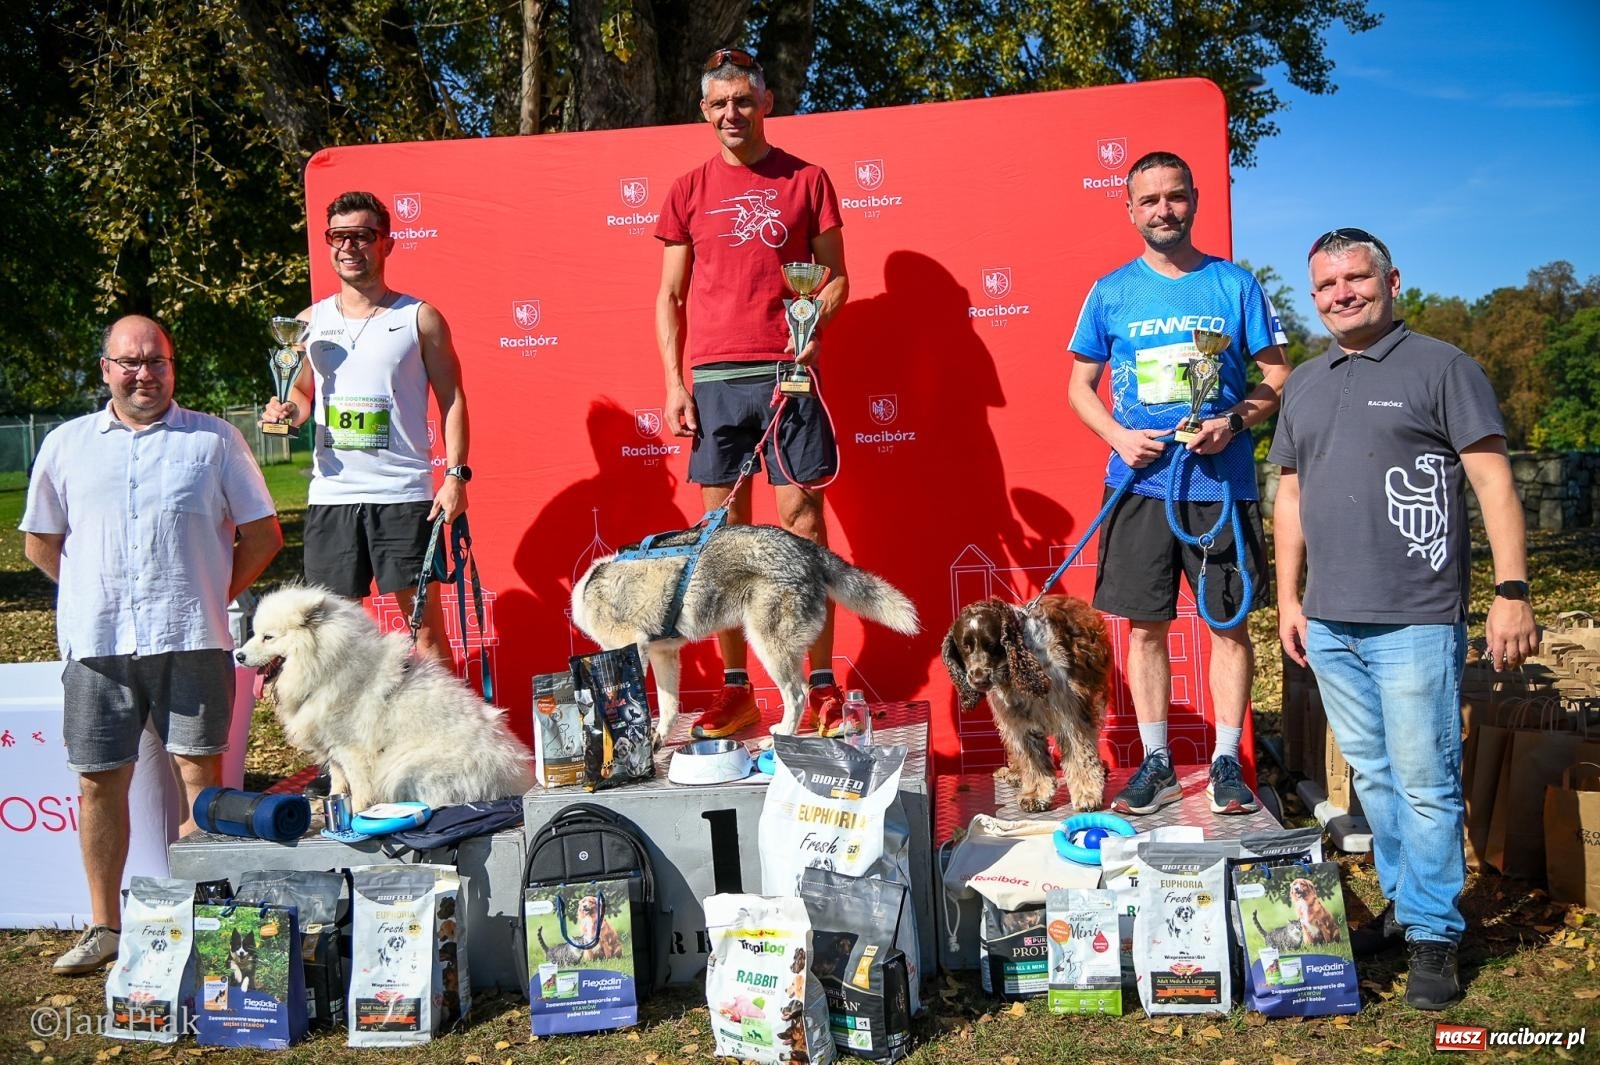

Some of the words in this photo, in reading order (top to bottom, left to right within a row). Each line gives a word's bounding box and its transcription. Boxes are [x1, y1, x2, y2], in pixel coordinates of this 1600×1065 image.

[1083, 175, 1129, 189] Racibó
[1106, 190, 1123, 199] 1217
[842, 195, 902, 209] Racibórz
[607, 212, 660, 226] Racibór
[864, 210, 880, 218] 1217
[390, 228, 438, 240] acibórz
[630, 228, 645, 236] 1217
[402, 242, 417, 251] 1217
[969, 304, 1029, 318] Racibórz
[992, 320, 1008, 329] 1217
[1127, 316, 1225, 338] TENNECO
[500, 335, 558, 348] Racibórz
[522, 350, 537, 359] 1217
[1368, 400, 1403, 408] RACIBÓRZ
[340, 411, 365, 429] 81
[856, 430, 916, 443] Racibórz
[622, 443, 680, 457] Racibórz
[878, 446, 894, 454] 1217
[811, 773, 865, 791] BIOFEED
[0, 796, 84, 832] OSi
[800, 832, 842, 855] Fresh
[701, 808, 743, 896] 1
[974, 875, 1030, 887] Racibórz
[1160, 879, 1204, 889] EUPHORIA
[1164, 891, 1193, 904] Fresh
[142, 925, 168, 936] Fresh
[377, 921, 404, 934] Fresh
[1069, 922, 1099, 941] Mini
[738, 938, 785, 956] TropiDog
[1012, 946, 1040, 957] PRO
[1305, 962, 1345, 974] Flexadin
[582, 978, 623, 989] Flexadin
[736, 969, 779, 989] RABBIT
